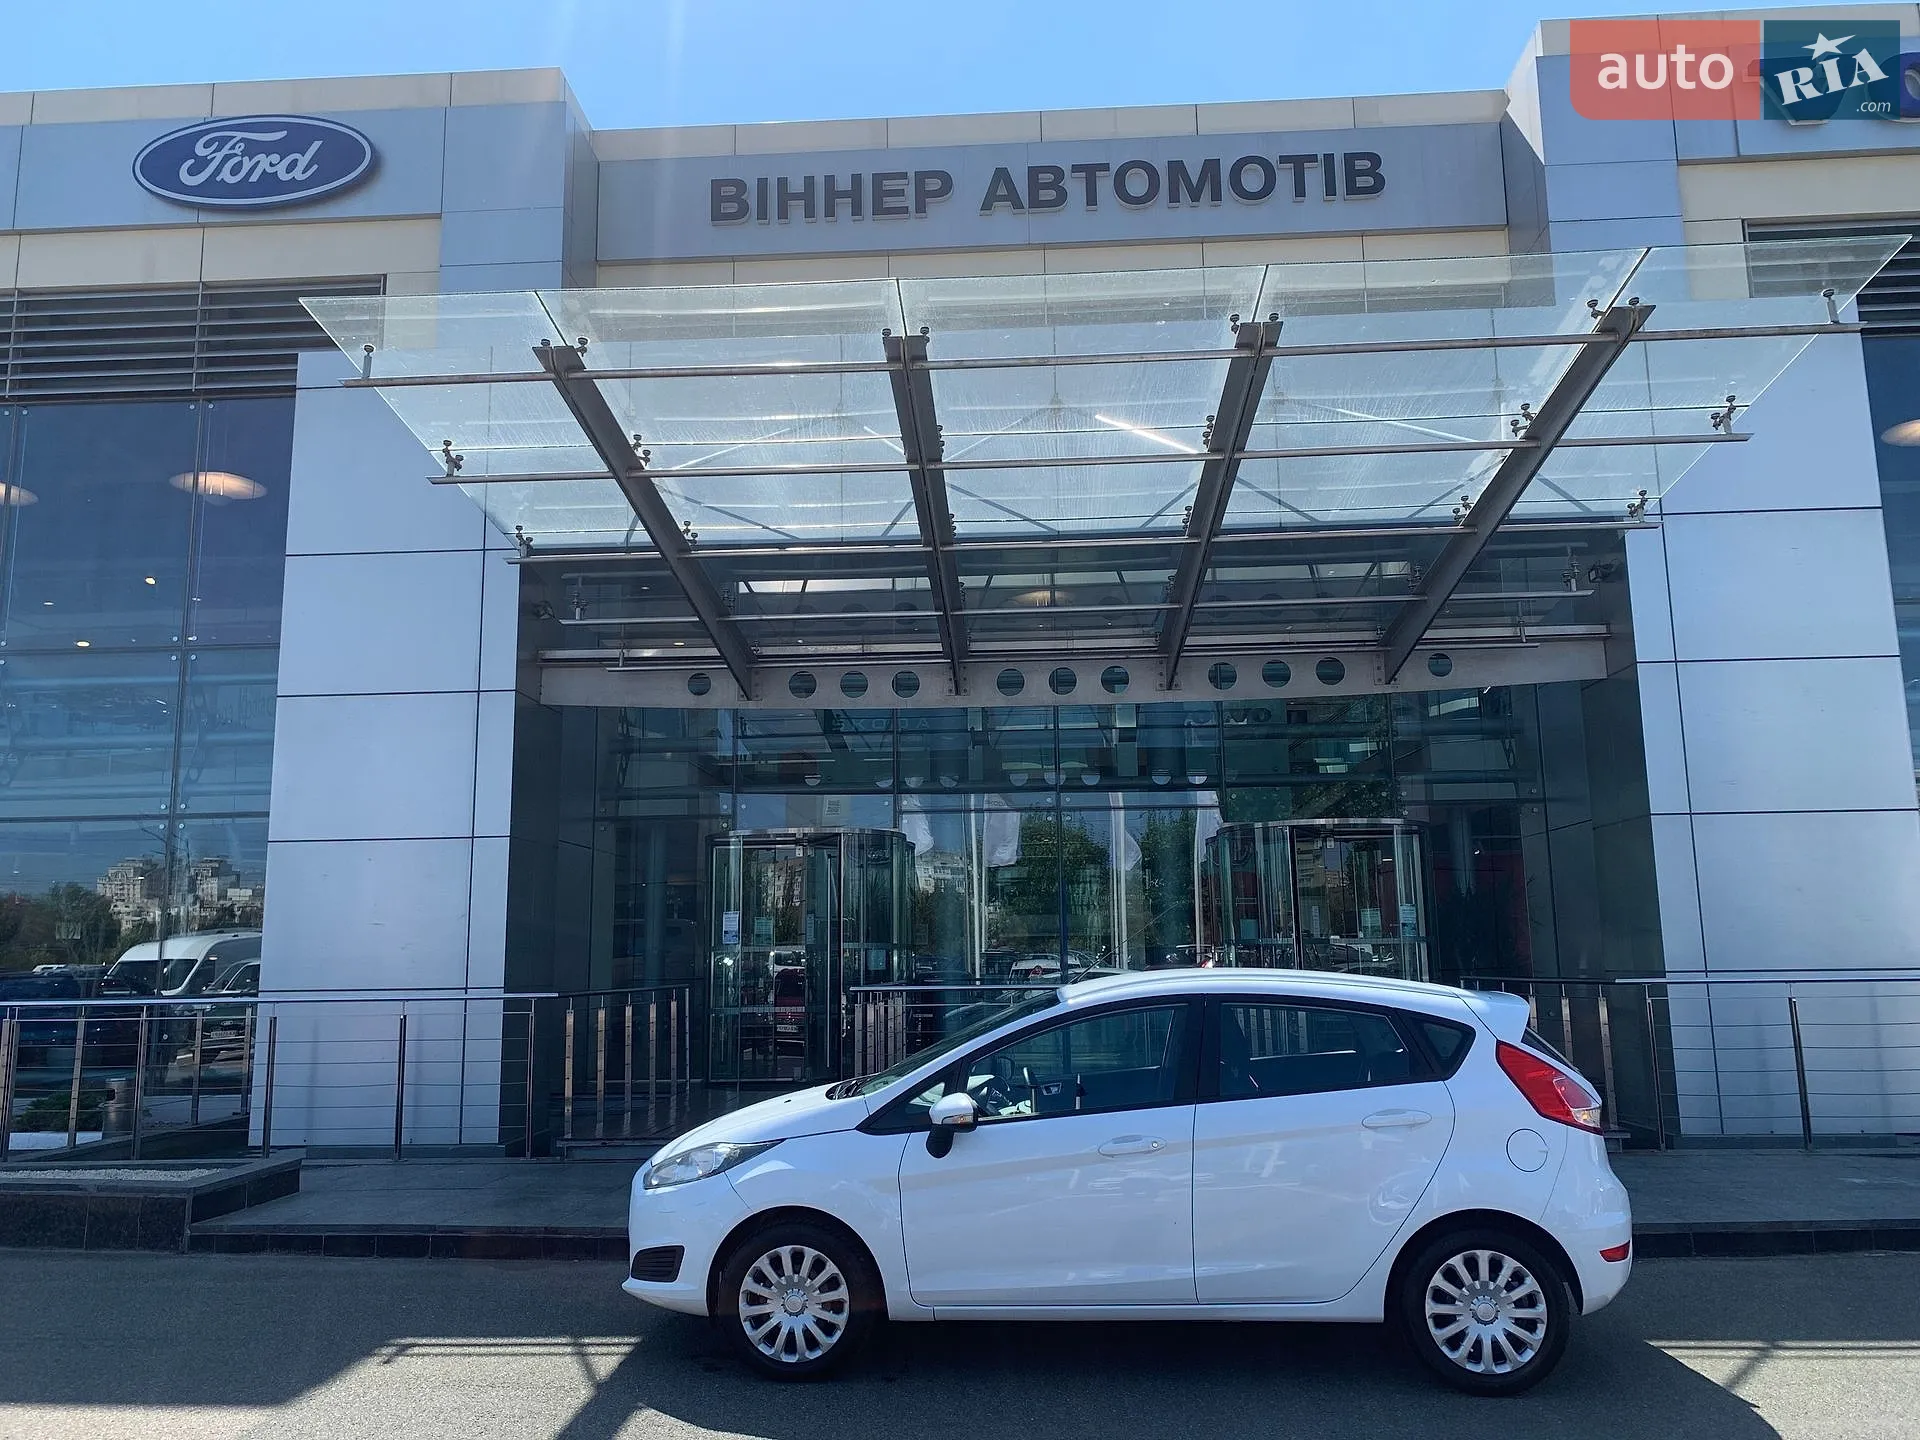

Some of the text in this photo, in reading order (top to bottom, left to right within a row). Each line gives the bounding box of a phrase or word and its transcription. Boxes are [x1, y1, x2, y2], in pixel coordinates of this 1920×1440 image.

[179, 130, 323, 186] Ford
[709, 151, 1386, 225] ВІННЕР АВТОМОТІВ
